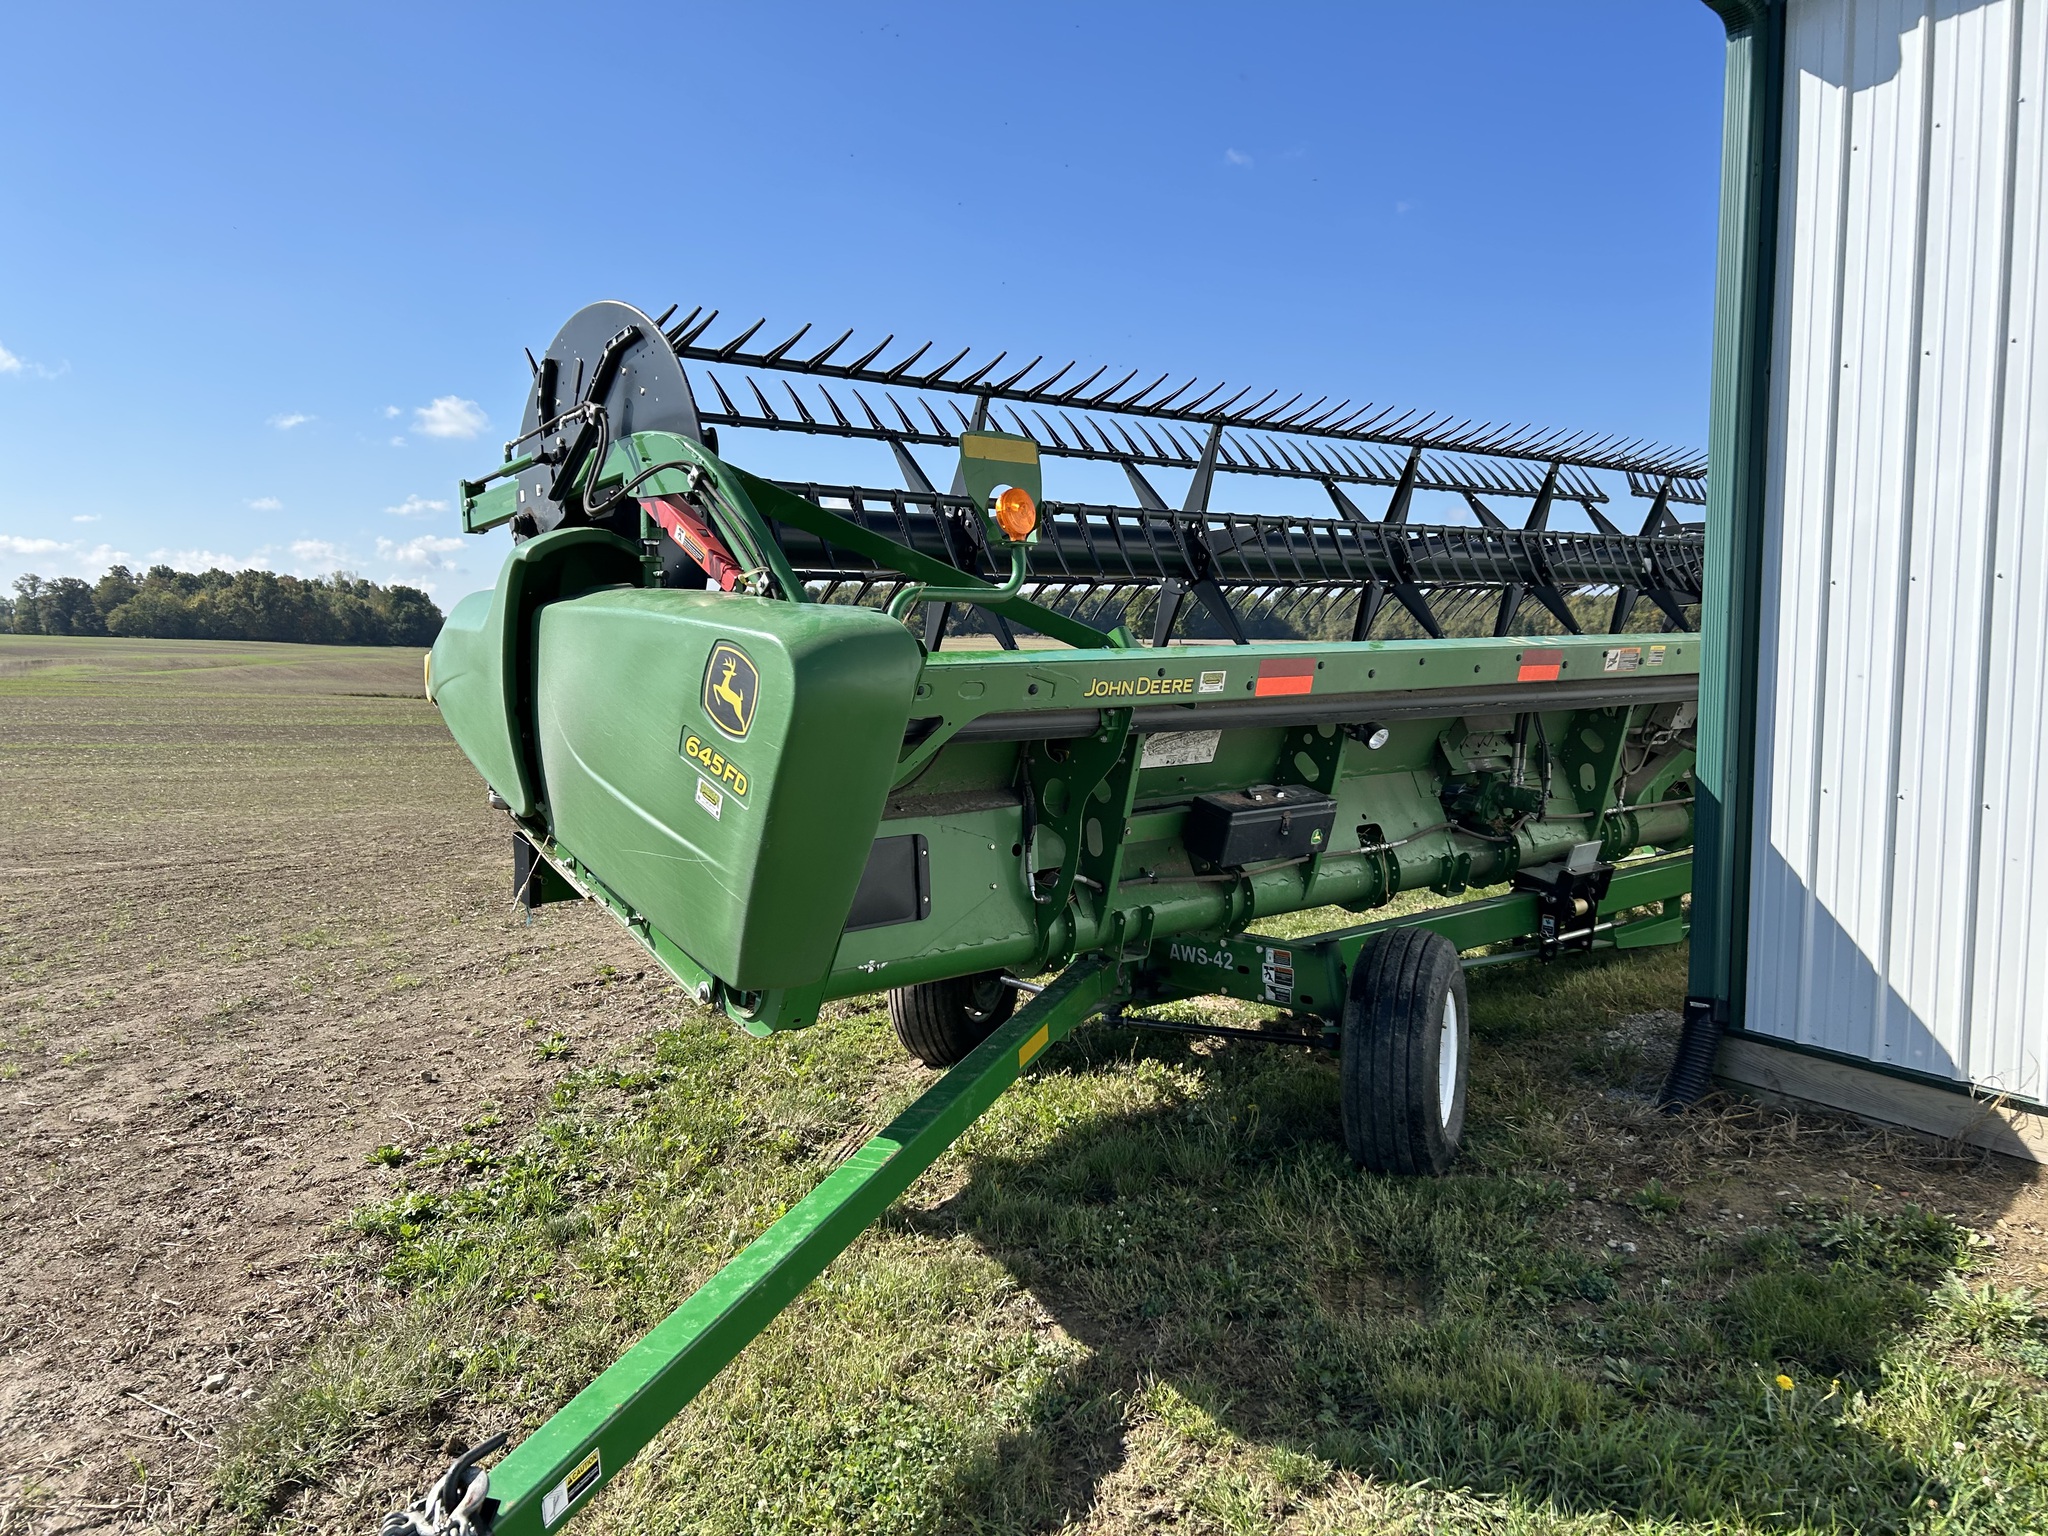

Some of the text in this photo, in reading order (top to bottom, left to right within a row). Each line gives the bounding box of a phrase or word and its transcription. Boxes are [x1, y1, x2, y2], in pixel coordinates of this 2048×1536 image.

[1083, 677, 1134, 698] JOHN
[1136, 676, 1195, 696] DEERE
[685, 735, 749, 797] 645FD
[1169, 943, 1234, 971] AWS-42
[571, 1453, 598, 1481] CAUTION
